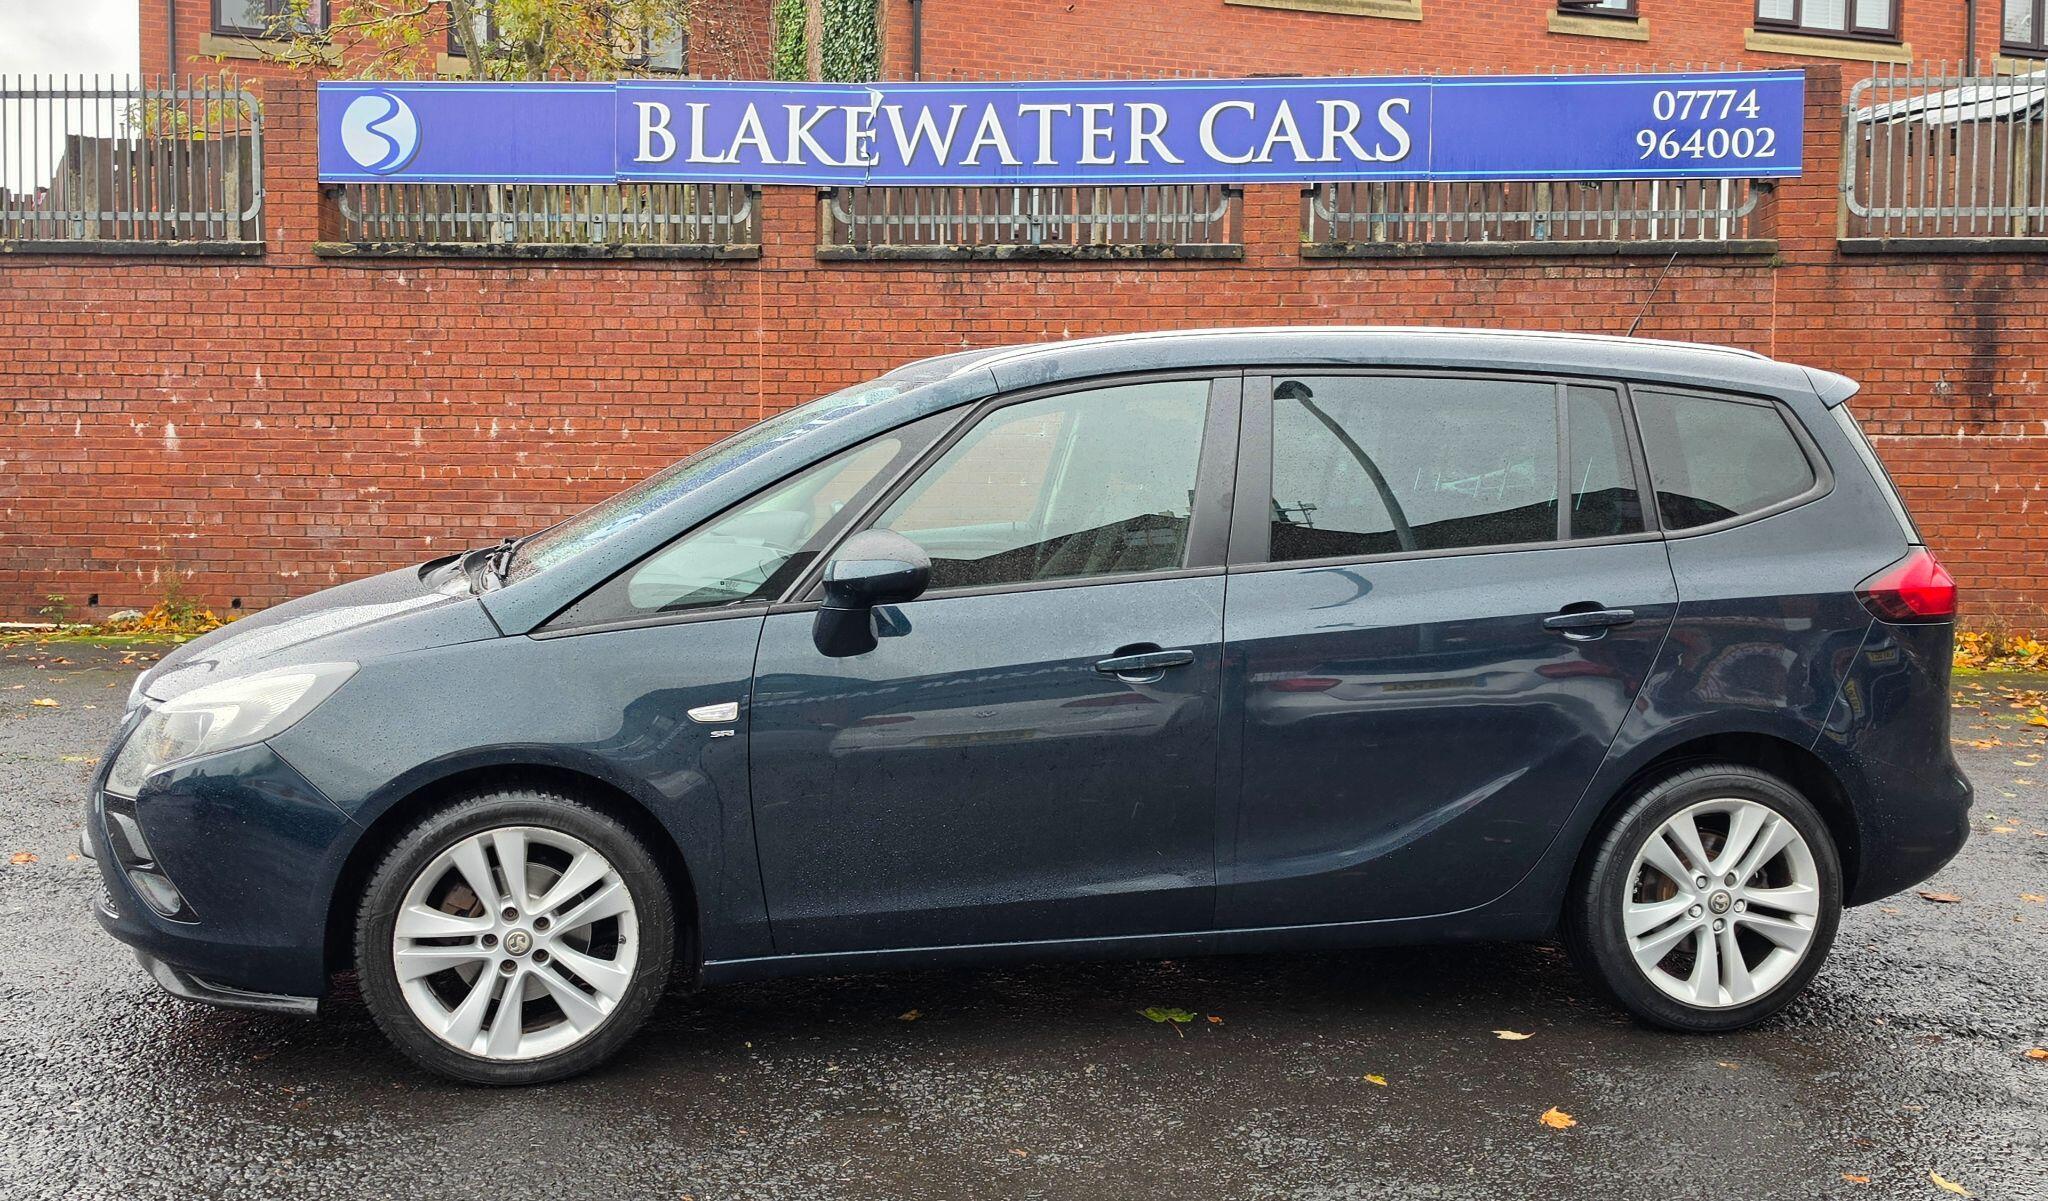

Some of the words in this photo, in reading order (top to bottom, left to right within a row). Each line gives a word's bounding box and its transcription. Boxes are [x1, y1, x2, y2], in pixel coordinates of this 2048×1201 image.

[1653, 88, 1761, 121] 07774
[632, 101, 1185, 167] BLAKEWATER
[1199, 97, 1411, 165] CARS
[1636, 127, 1776, 160] 964002
